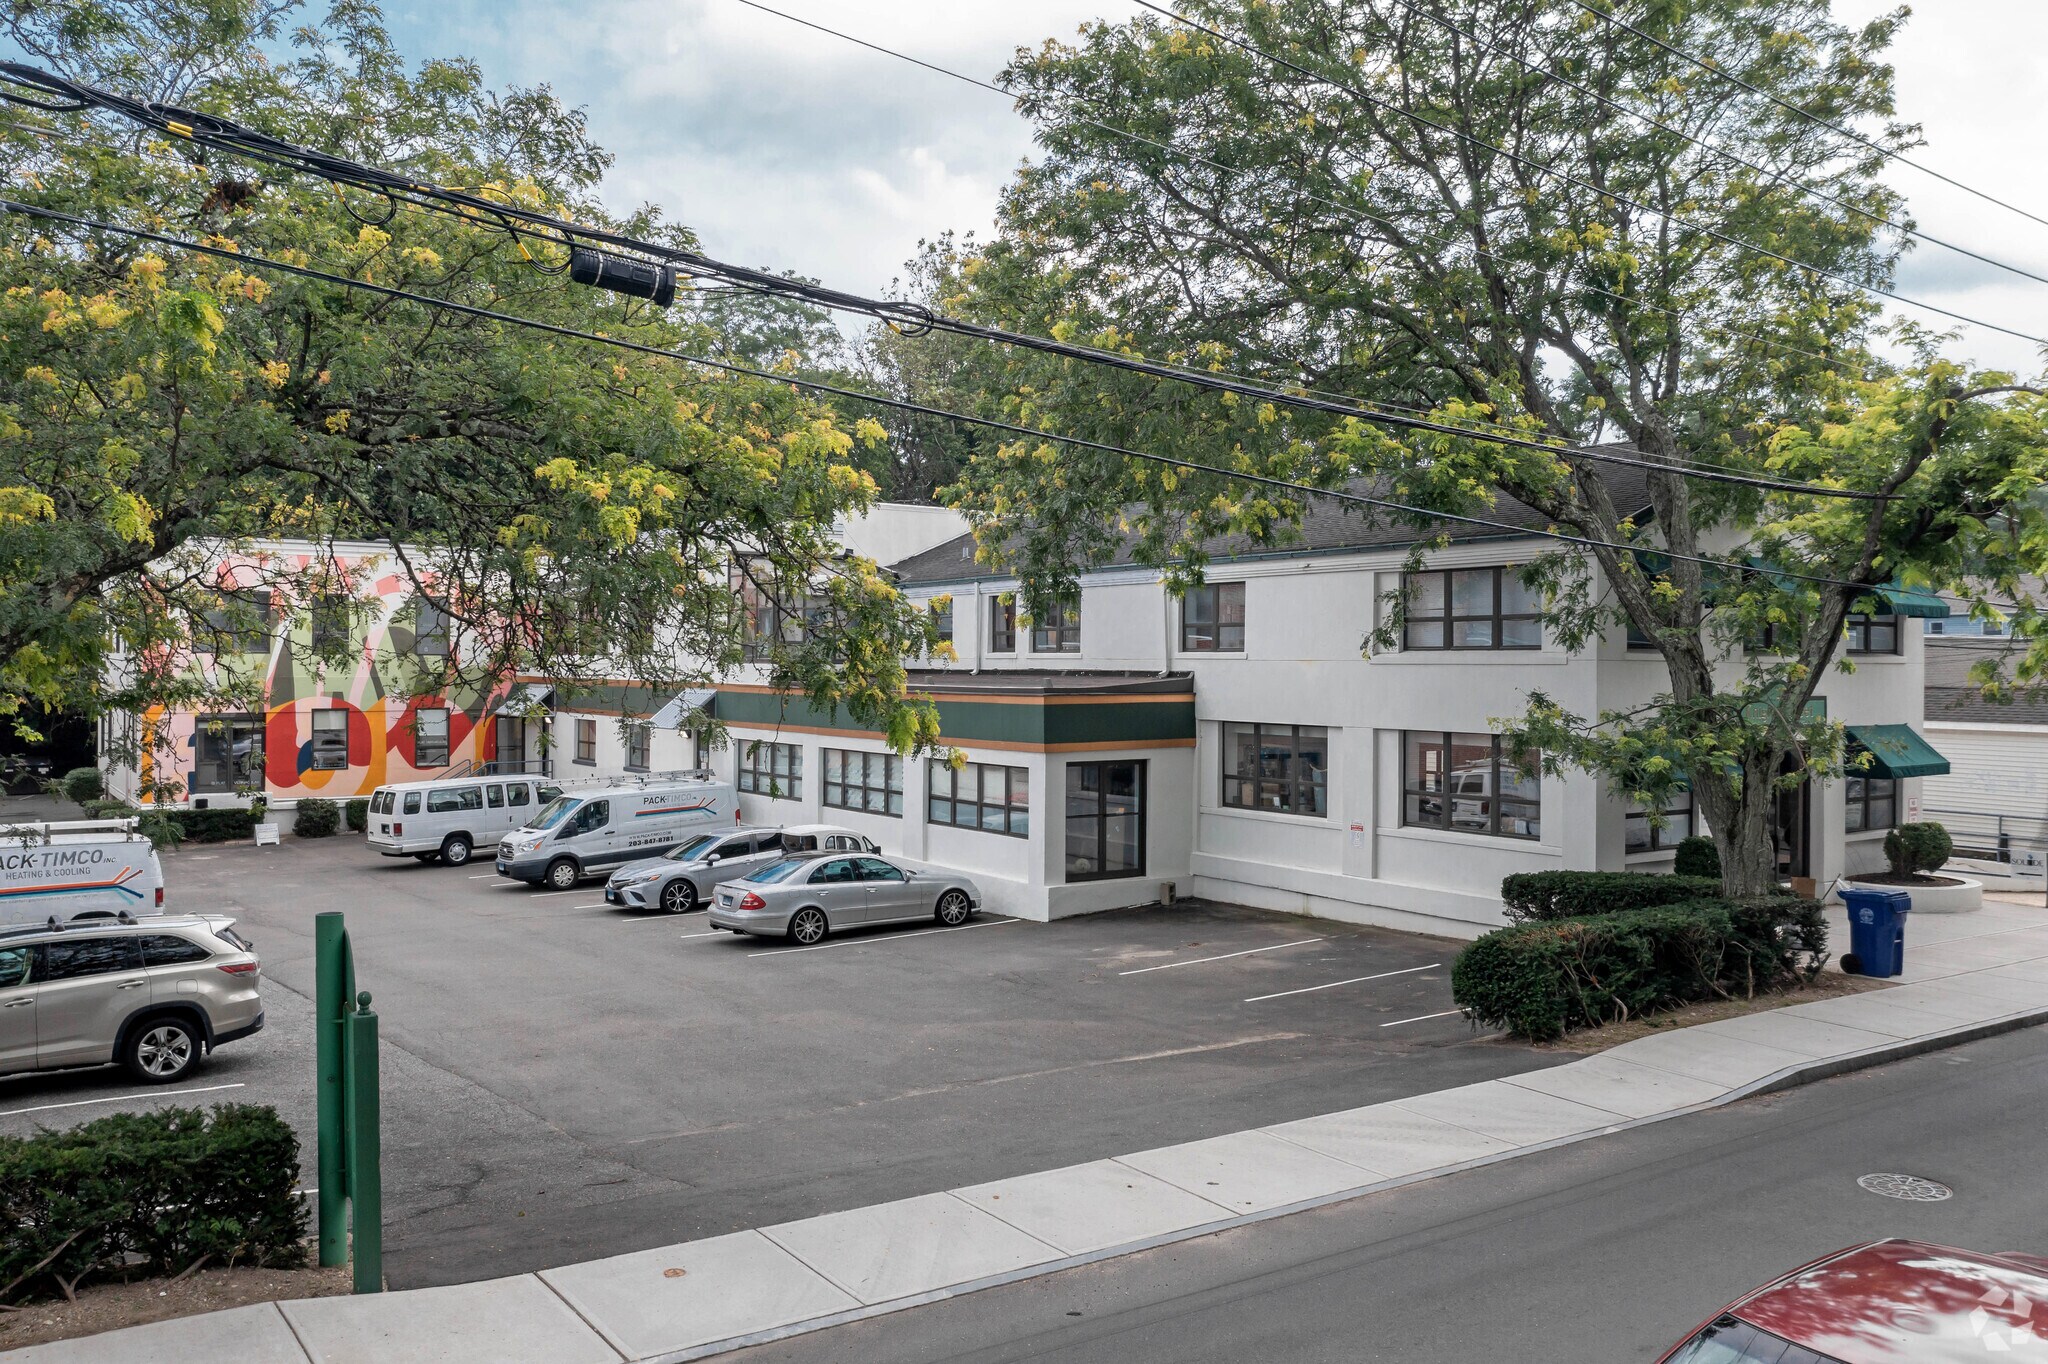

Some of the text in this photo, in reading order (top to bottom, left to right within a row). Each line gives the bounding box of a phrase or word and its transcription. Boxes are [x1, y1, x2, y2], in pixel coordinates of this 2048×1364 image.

[643, 793, 692, 805] PACK-TIMCO
[628, 836, 674, 847] 203-847-8781
[6, 867, 91, 880] HEATING & COOLING
